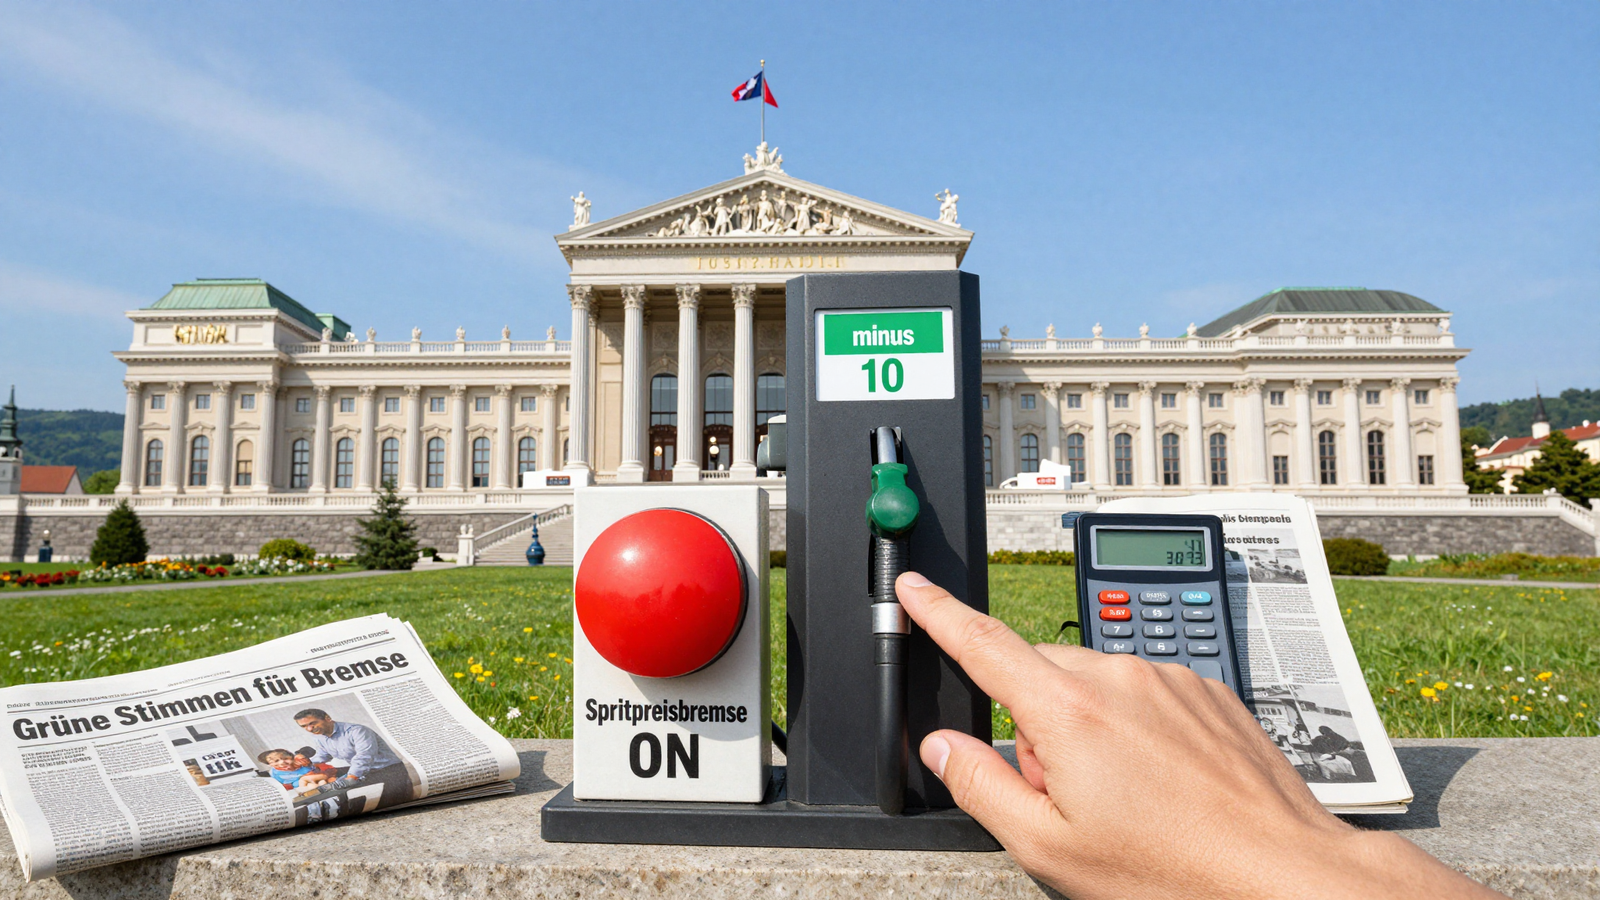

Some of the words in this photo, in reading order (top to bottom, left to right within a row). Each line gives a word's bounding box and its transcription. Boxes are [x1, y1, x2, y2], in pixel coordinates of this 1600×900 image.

[852, 324, 915, 347] minus
[861, 357, 905, 393] 10
[1113, 625, 1121, 634] 7
[12, 714, 112, 741] Grüne
[114, 688, 253, 726] Stimmen
[252, 675, 298, 699] für
[300, 652, 410, 690] Bremse
[585, 698, 748, 726] Spritpreisbremse
[629, 732, 699, 779] ON
